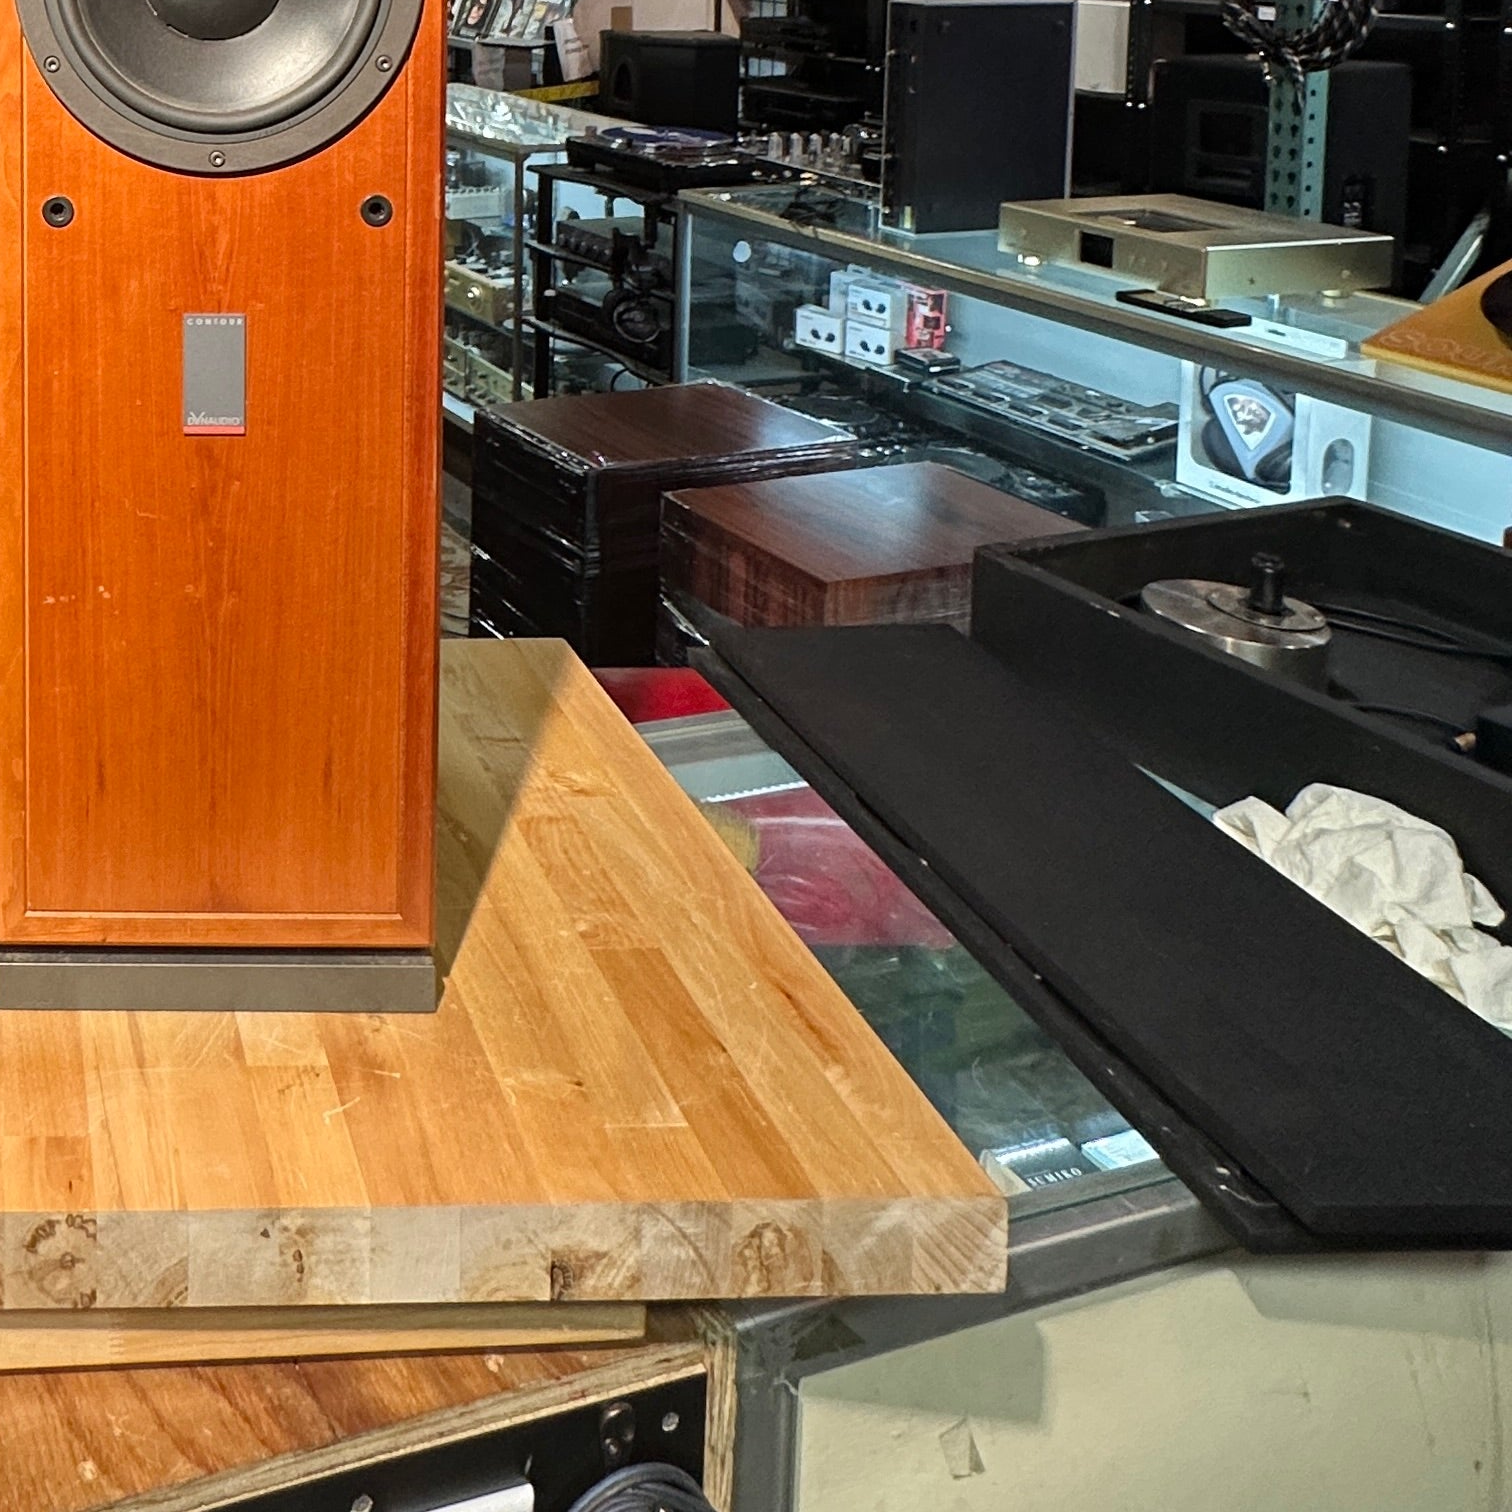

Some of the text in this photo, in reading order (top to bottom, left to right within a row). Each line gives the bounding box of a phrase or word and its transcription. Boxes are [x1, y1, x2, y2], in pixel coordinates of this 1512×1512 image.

[185, 317, 243, 326] CONTOUR
[186, 411, 241, 426] DYNAUDIO
[1027, 1167, 1083, 1188] SUMIKO
